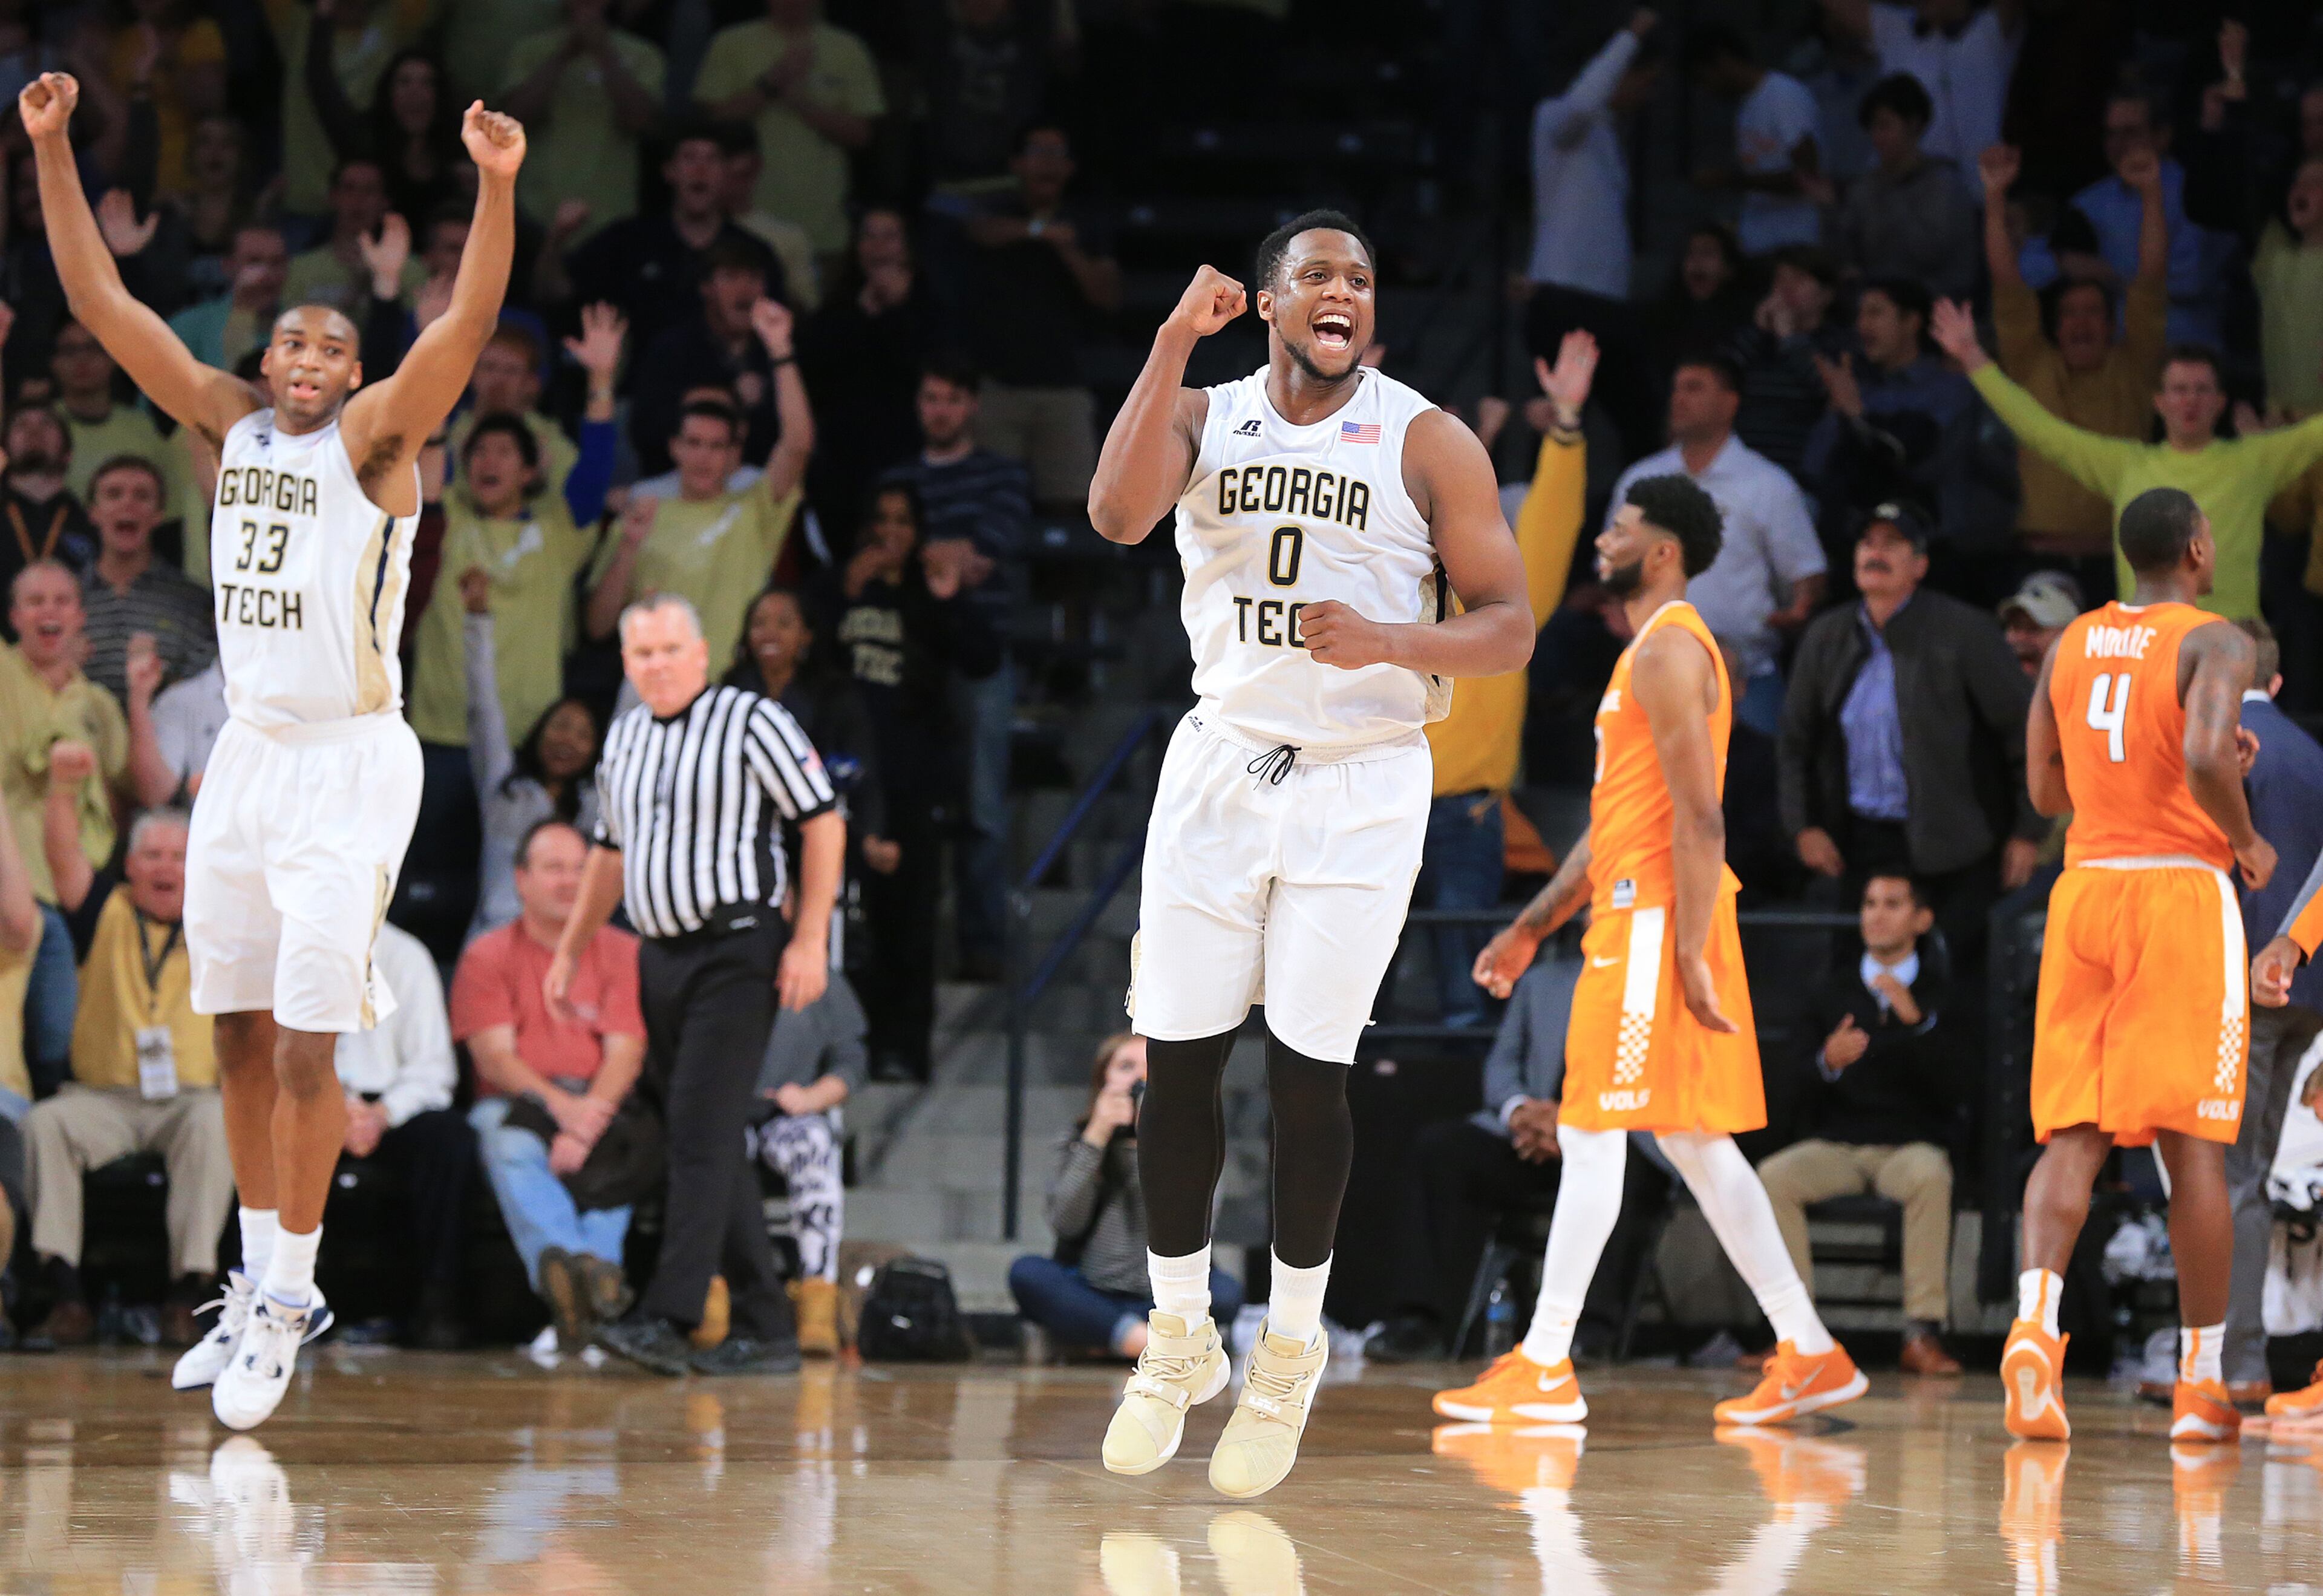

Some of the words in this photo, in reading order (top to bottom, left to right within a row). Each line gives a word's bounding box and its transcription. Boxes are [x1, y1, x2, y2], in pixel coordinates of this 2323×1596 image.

[1232, 429, 1261, 437] RUSSELL
[220, 467, 317, 517] GORGIA
[1218, 465, 1370, 532] GEORGIA
[235, 518, 289, 574] 33
[1267, 523, 1304, 588] 0
[220, 583, 302, 630] TECH
[1232, 596, 1310, 648] TEC
[2085, 672, 2132, 763] 4
[1599, 1088, 1651, 1111] VOLS
[2198, 1098, 2240, 1120] VOLS
